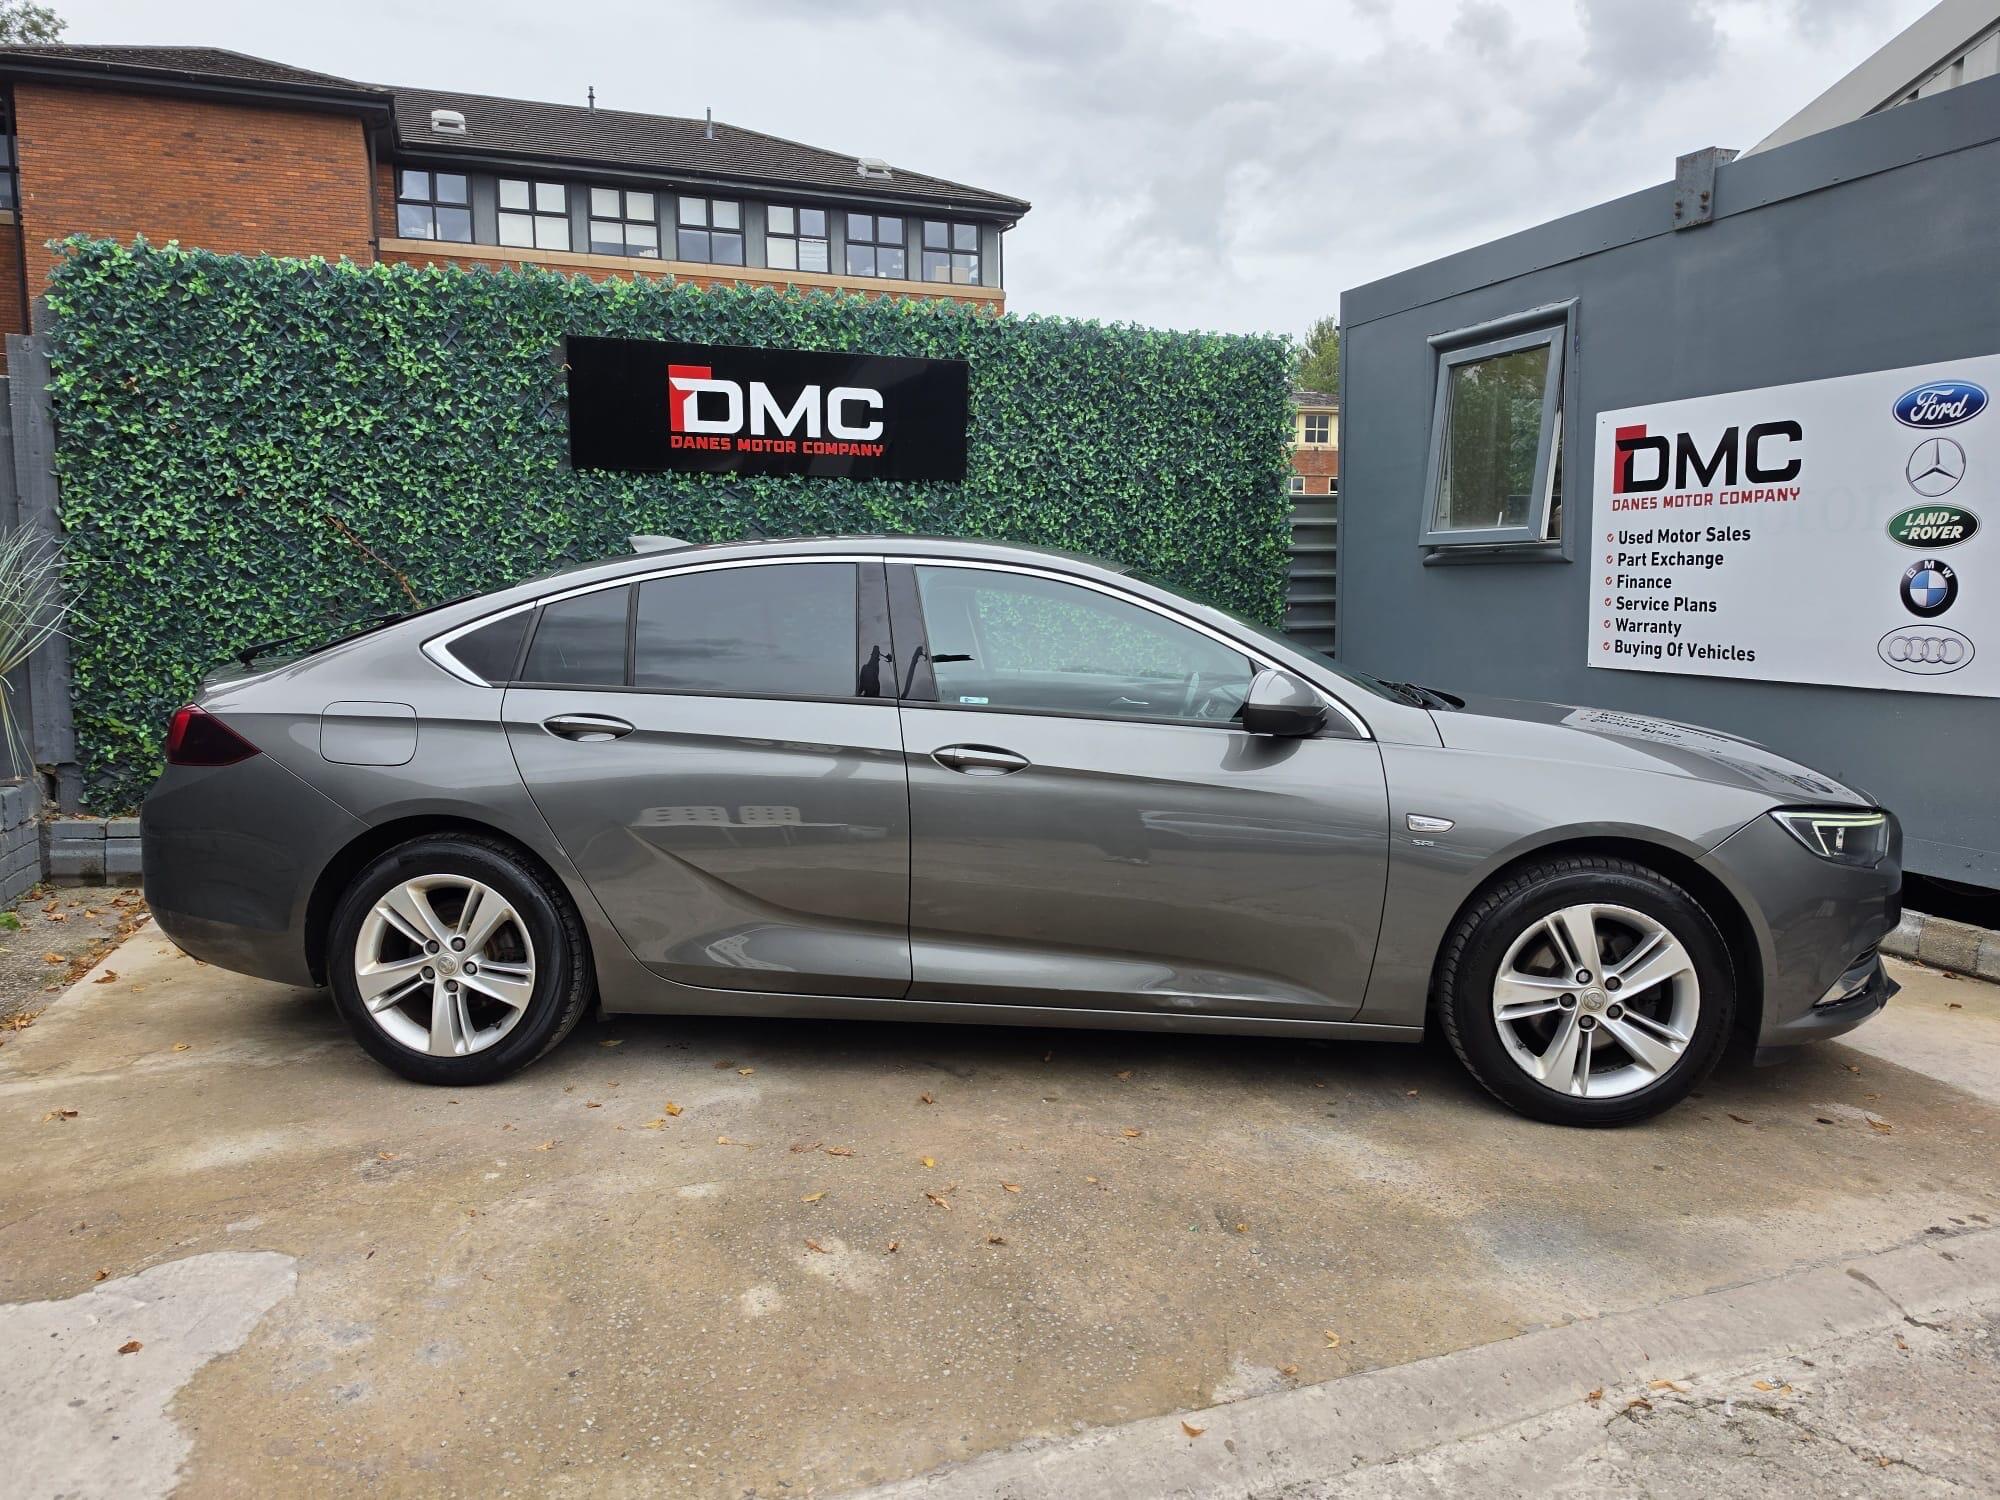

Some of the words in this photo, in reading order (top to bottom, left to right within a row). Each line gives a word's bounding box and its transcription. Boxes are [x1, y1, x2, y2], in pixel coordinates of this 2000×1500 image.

[668, 376, 884, 441] DMC
[1910, 388, 1969, 422] Ford
[670, 435, 731, 450] DANES
[737, 438, 797, 453] MOTOR
[803, 441, 884, 457] COMPANY
[1614, 420, 1803, 494] DMC
[1612, 496, 1657, 511] DANES
[1663, 493, 1713, 509] MOTOR
[1719, 487, 1801, 505] COMPANY
[1618, 530, 1653, 544] Used
[1657, 529, 1701, 543] Motor
[1706, 526, 1751, 542] Sales
[1617, 553, 1647, 567] Part
[1651, 551, 1724, 569] Exchange
[1905, 560, 1954, 579] BMW
[1616, 574, 1672, 589] Finance
[1616, 596, 1669, 611] Service
[1674, 597, 1717, 612] Plans
[1615, 618, 1682, 637] Warranty
[1614, 639, 1662, 659] Buying
[1667, 642, 1683, 657] Of
[1687, 643, 1756, 662] Vehicles
